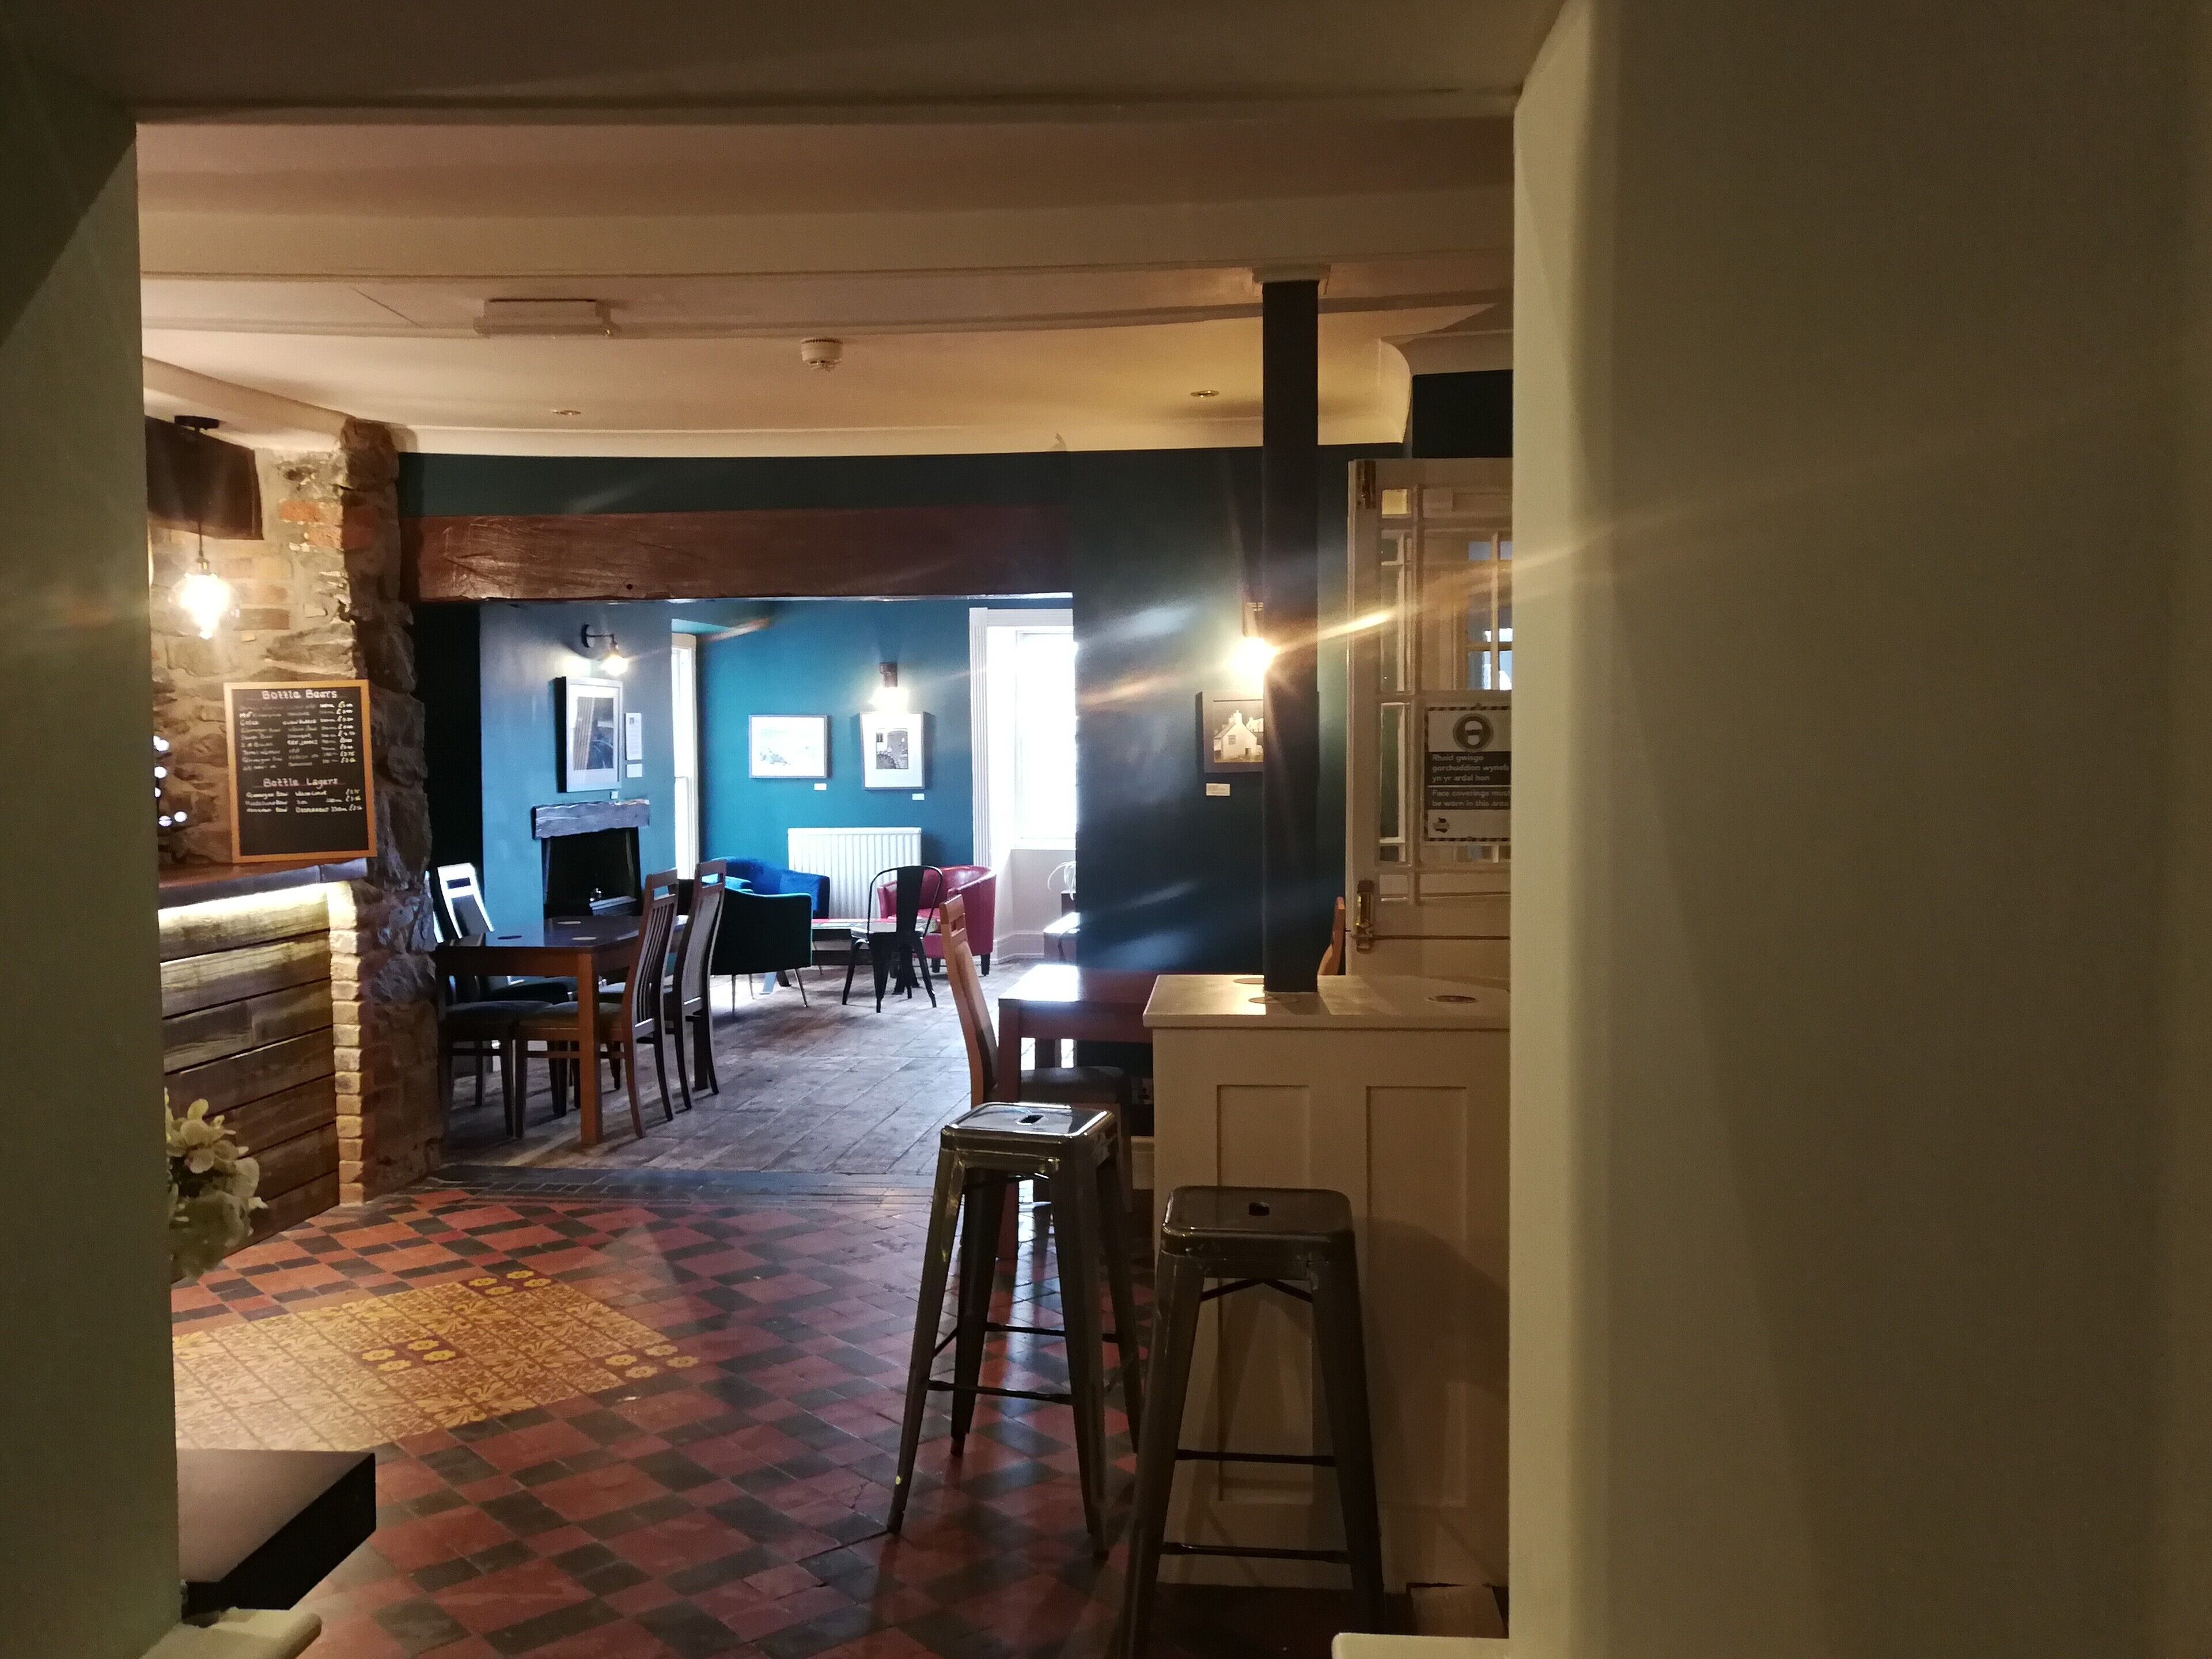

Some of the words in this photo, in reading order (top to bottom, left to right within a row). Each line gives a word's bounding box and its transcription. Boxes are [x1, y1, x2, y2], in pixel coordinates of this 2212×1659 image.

[262, 690, 301, 700] Bottle
[1456, 755, 1484, 763] gwisgo
[1432, 764, 1481, 773] gorchuddion
[263, 778, 300, 788] Bottle
[306, 778, 338, 790] Lagers
[1452, 789, 1490, 798] coverings
